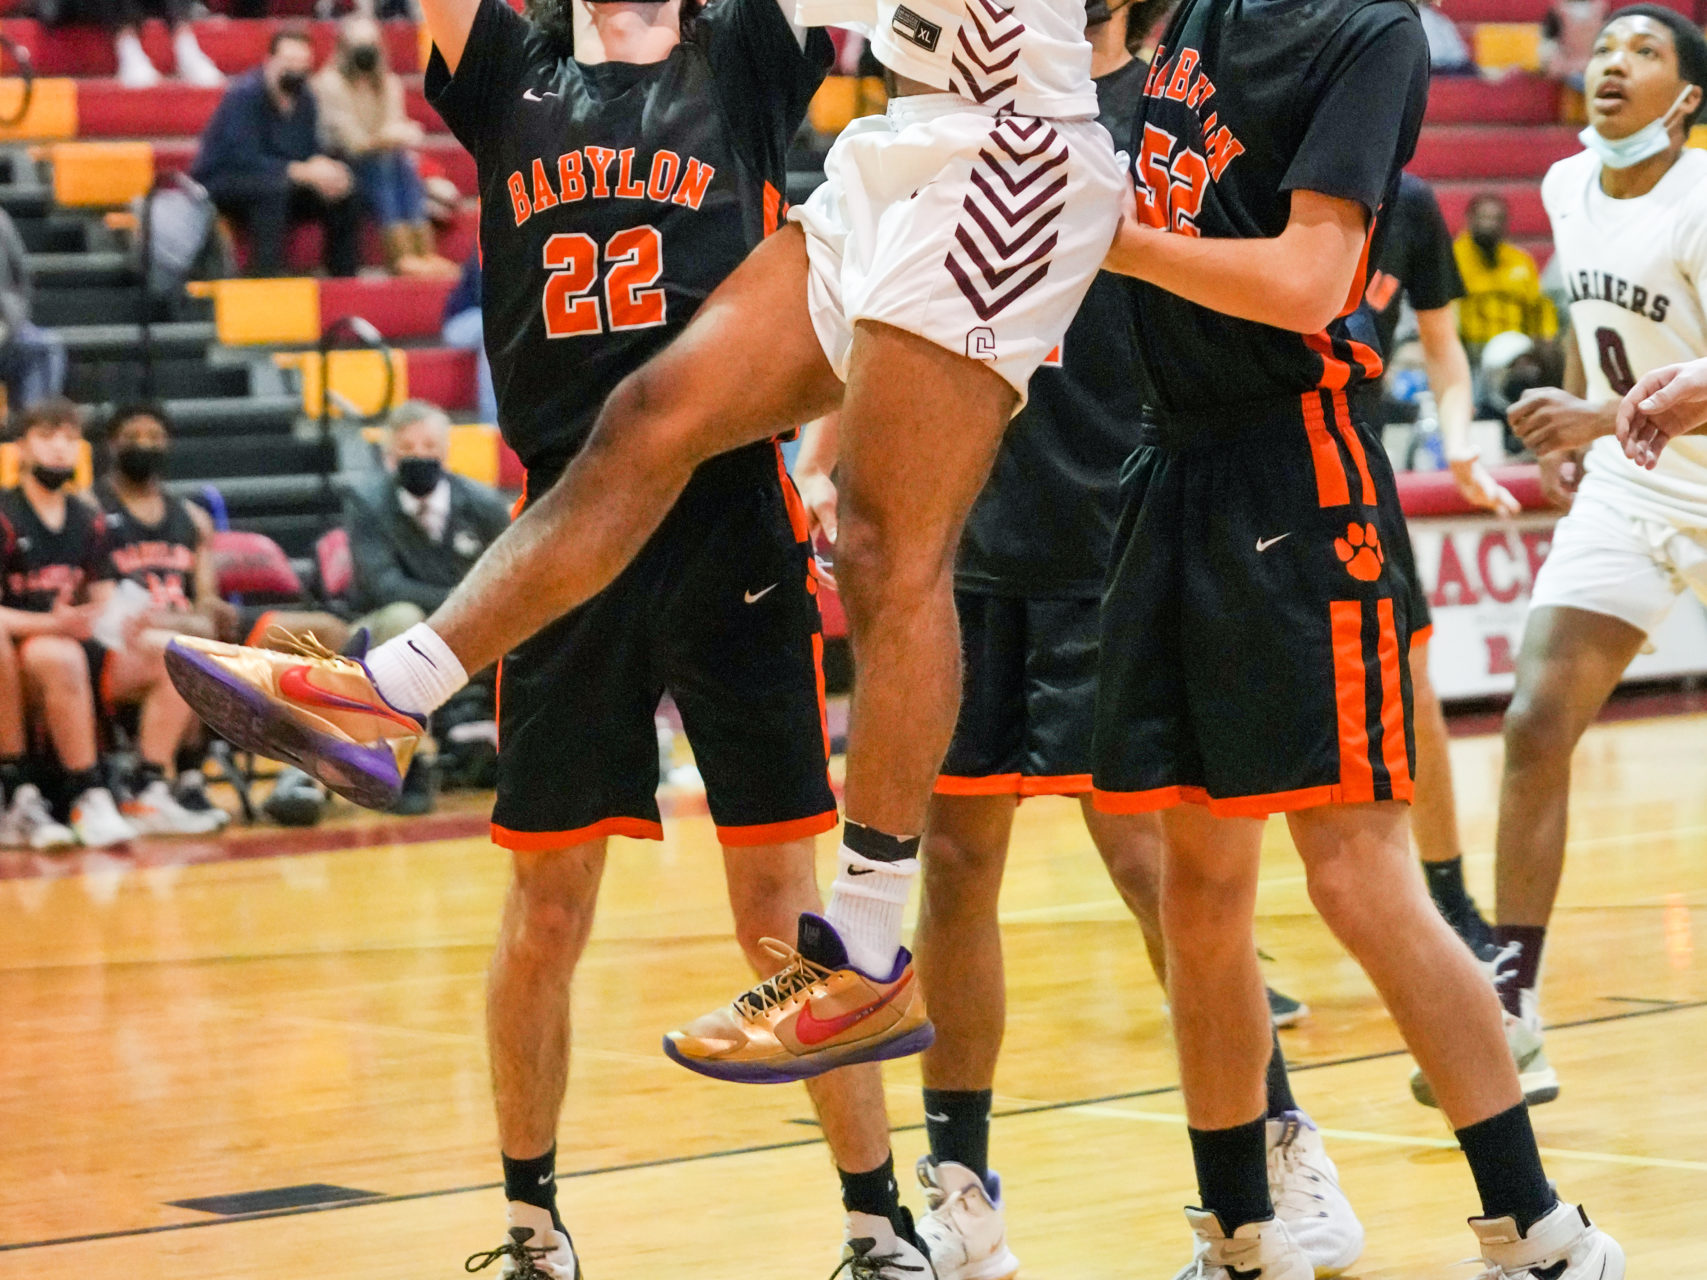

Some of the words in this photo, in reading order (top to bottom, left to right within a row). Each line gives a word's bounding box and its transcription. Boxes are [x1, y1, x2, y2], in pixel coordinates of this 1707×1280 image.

[917, 27, 931, 43] XL
[507, 145, 716, 227] BABYLON
[1136, 121, 1210, 238] 52
[542, 224, 667, 339] 22
[1594, 325, 1637, 397] 0
